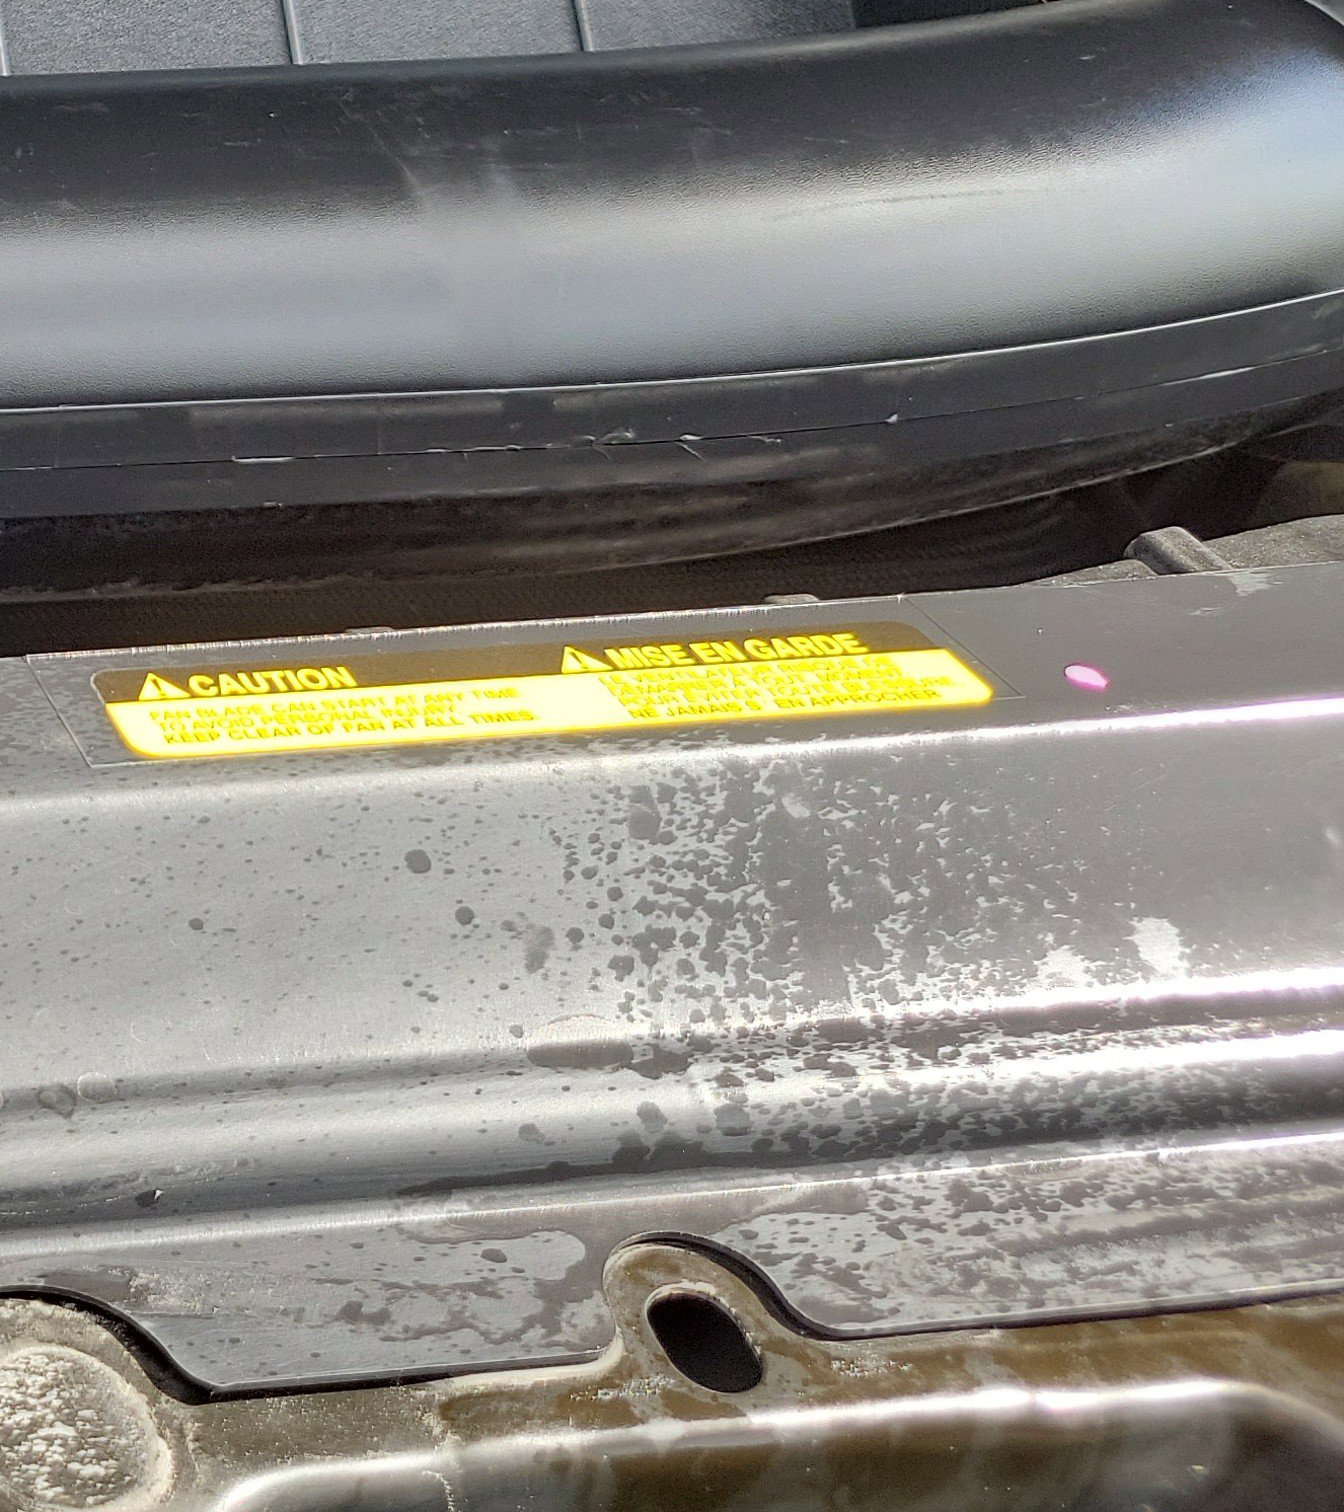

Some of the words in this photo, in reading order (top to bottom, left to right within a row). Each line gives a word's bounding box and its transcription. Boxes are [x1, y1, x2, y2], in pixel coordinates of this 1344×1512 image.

[604, 645, 695, 669] MISE
[689, 640, 746, 664] EN
[743, 633, 869, 660] GARDE
[188, 666, 358, 697] CAUTION
[164, 729, 221, 744] KEEP
[228, 725, 301, 740] CLEAR
[307, 722, 334, 735] OF
[342, 719, 385, 734] FAN
[392, 716, 417, 729] AT
[424, 713, 465, 727] ALL
